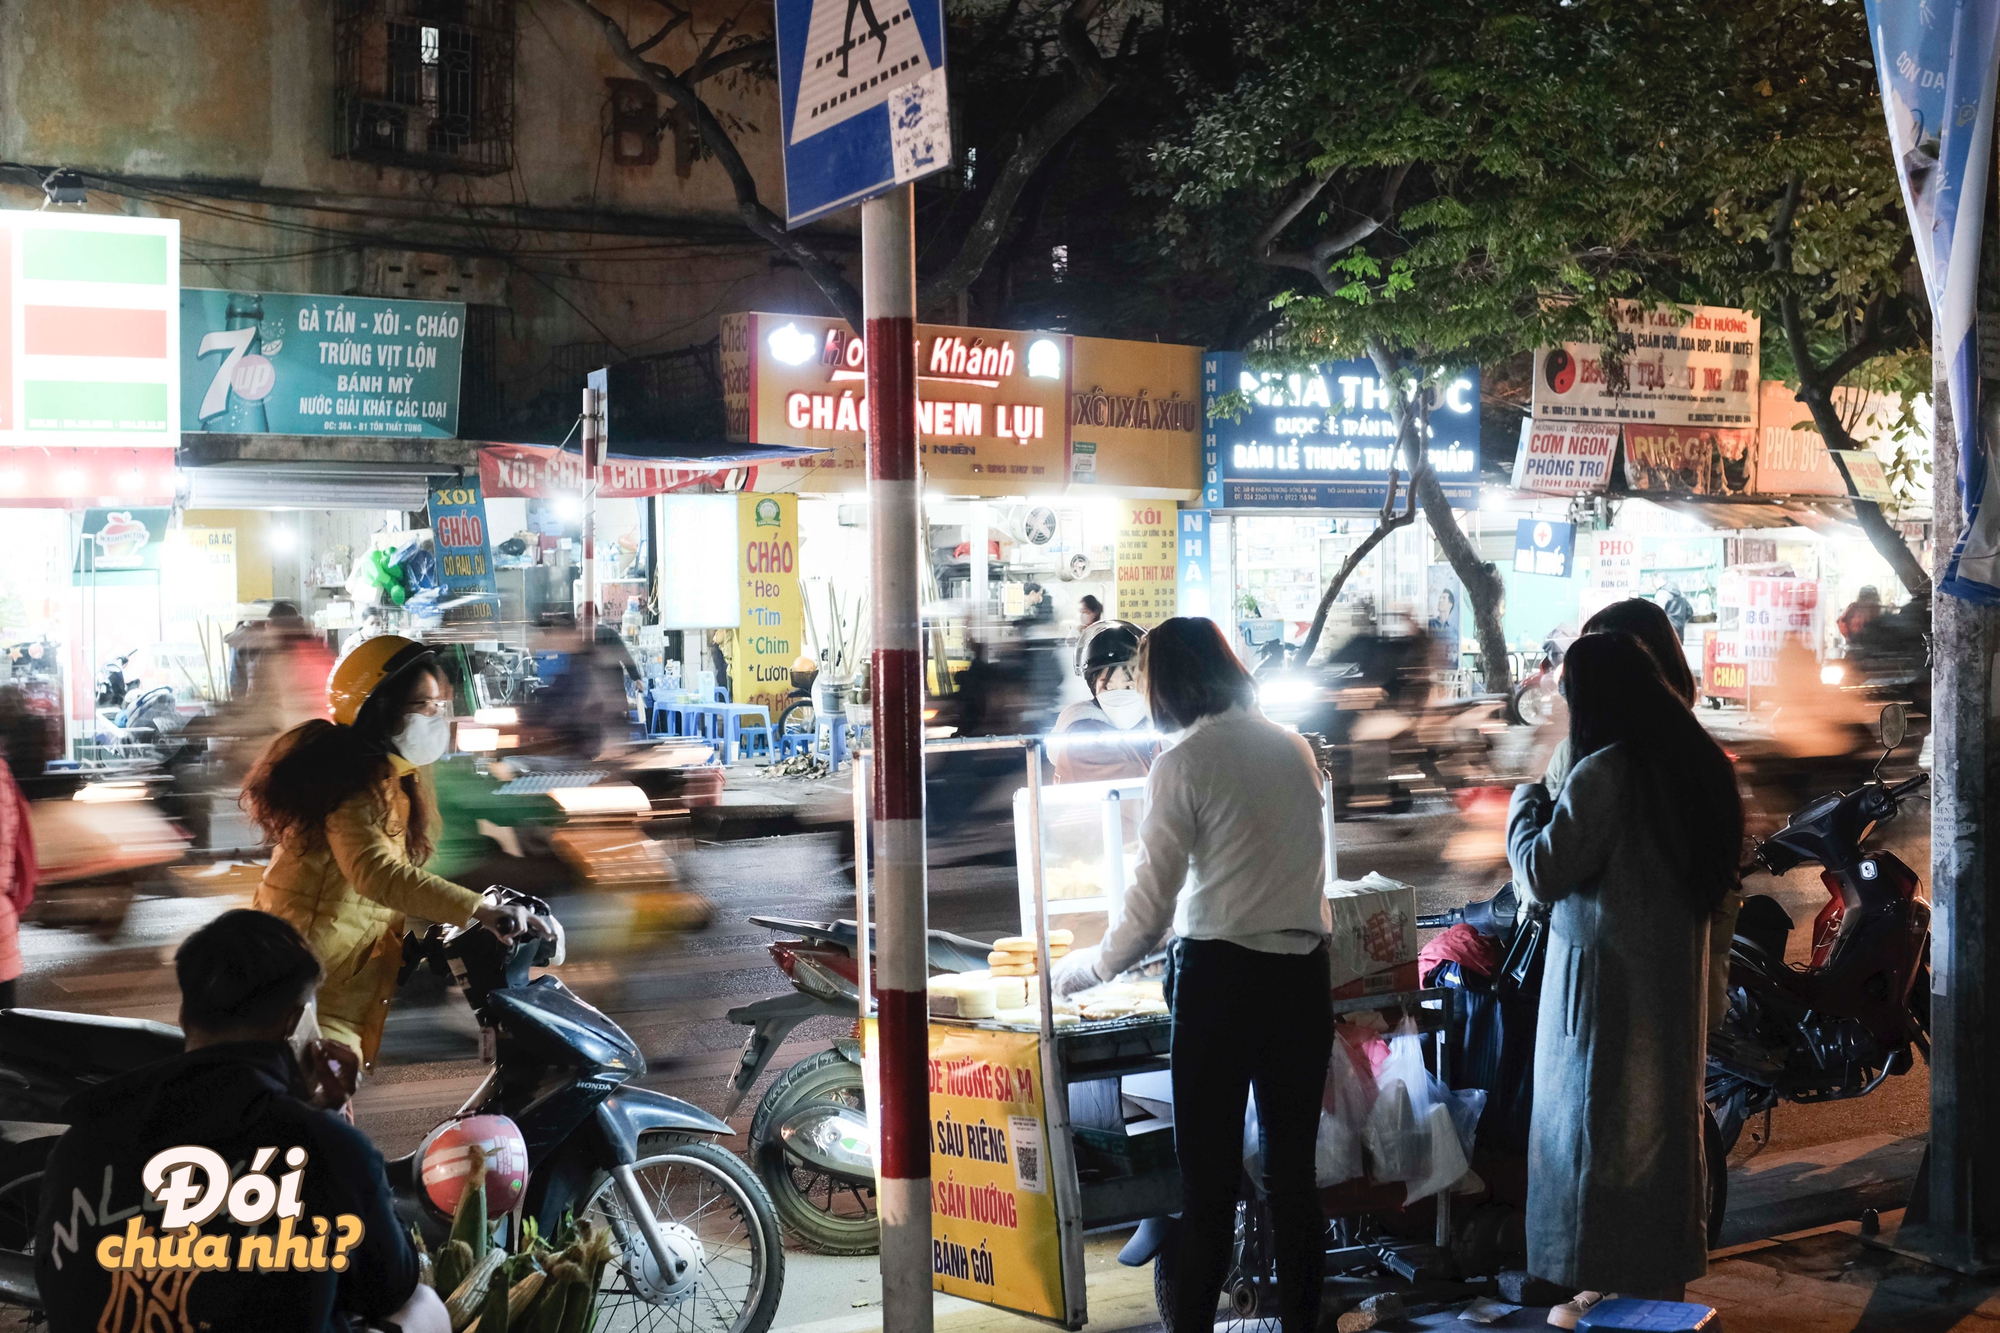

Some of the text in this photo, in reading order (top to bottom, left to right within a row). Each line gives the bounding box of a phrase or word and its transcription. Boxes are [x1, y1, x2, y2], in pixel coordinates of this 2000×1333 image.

[1896, 51, 1921, 82] CON
[299, 303, 459, 338] GÀ TẦN XÔI CHÁO
[1714, 315, 1747, 333] HƯƠNG
[722, 316, 748, 353] Cháo
[319, 338, 436, 372] TRỨNG VỊT LỘN
[930, 336, 1015, 376] Khánh
[337, 371, 414, 394] BÁNH MỲ
[299, 395, 447, 421] NƯỚC GIẢI KHÁT CÁC LOẠI
[1078, 387, 1196, 432] XÔI XÁ XÍU
[915, 401, 982, 436] NEM
[996, 405, 1044, 445] LỤI
[1276, 416, 1321, 438] DƯỢC
[1342, 414, 1380, 437] TRẦN
[1233, 440, 1274, 469] BÁN
[1277, 438, 1299, 470] LẺ
[1303, 440, 1360, 471] THUỐC
[1364, 444, 1409, 472] THÀN
[1530, 434, 1609, 456] CƠM NGON
[1634, 428, 1682, 461] PHỞ
[1526, 455, 1575, 477] PHÒNG
[1532, 477, 1561, 488] BÌNH
[438, 509, 483, 548] CHÁO
[1132, 507, 1161, 525] XÔI
[100, 533, 146, 543] WASHINGTON
[455, 554, 475, 578] RAU,
[746, 533, 793, 573] CHÁO
[1514, 543, 1565, 576] NHÀ THUỐC
[1118, 563, 1175, 584] CHÁO THỊT XAY
[755, 580, 780, 597] Heo
[755, 608, 781, 626] Tim
[1253, 623, 1275, 631] tanakan
[756, 636, 789, 654] Chim
[757, 664, 788, 682] Lươn
[576, 1082, 612, 1091] HONDA
[947, 1054, 993, 1100] NƯỚNG
[996, 1065, 1014, 1102] SA
[937, 1110, 1008, 1164] SẦU RIÊNG
[938, 1170, 1018, 1229] SẮN NƯỚNG
[934, 1234, 995, 1287] BÁNH GỐI
